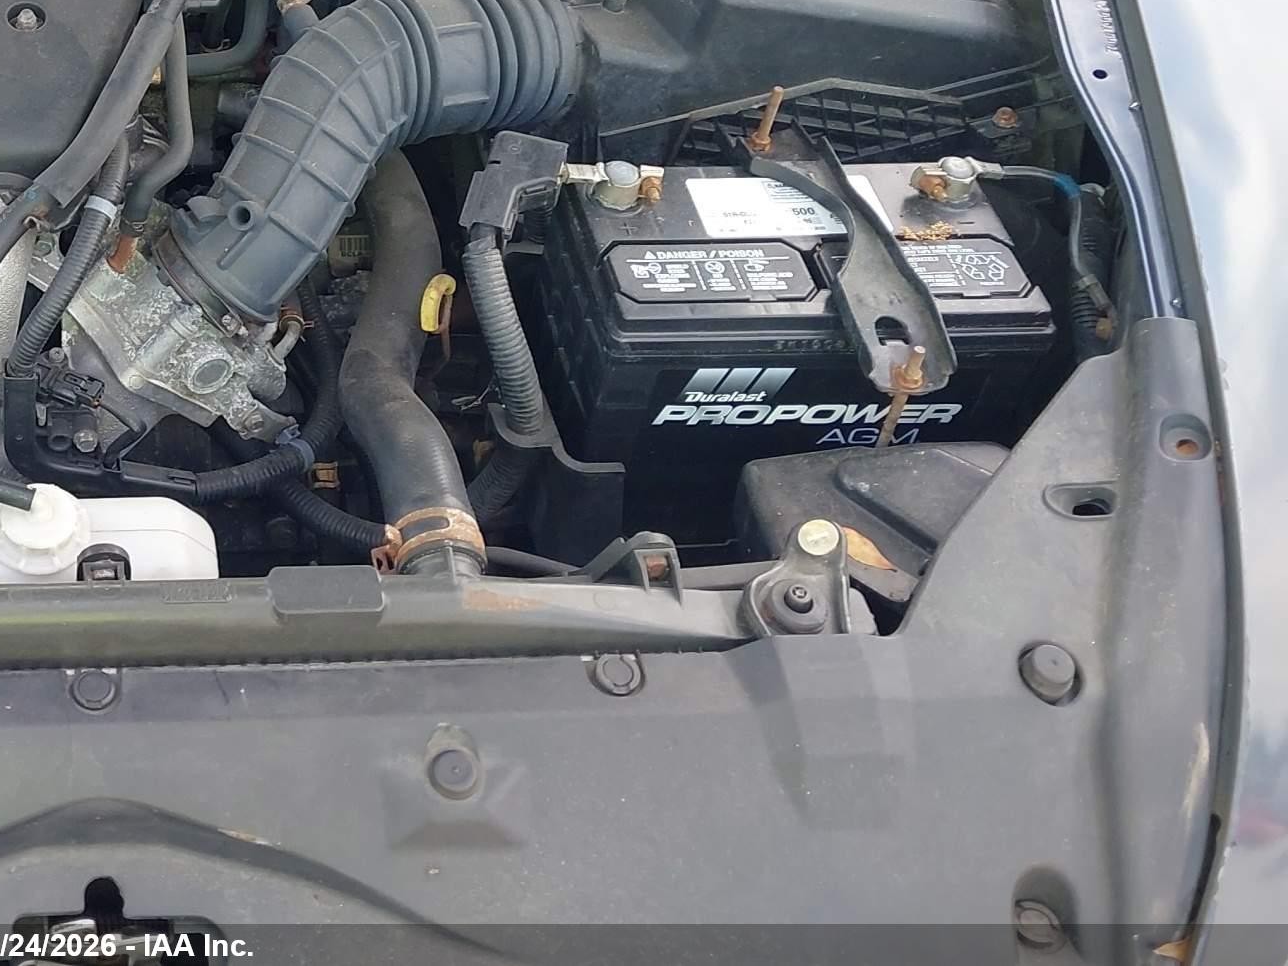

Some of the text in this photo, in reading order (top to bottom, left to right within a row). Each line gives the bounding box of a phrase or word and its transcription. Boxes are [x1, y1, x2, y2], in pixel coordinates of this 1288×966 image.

[656, 250, 708, 260] DANGER
[718, 249, 765, 259] POISON
[684, 390, 768, 404] Duralast
[651, 404, 963, 426] PROPOWER
[815, 428, 920, 445] AGM
